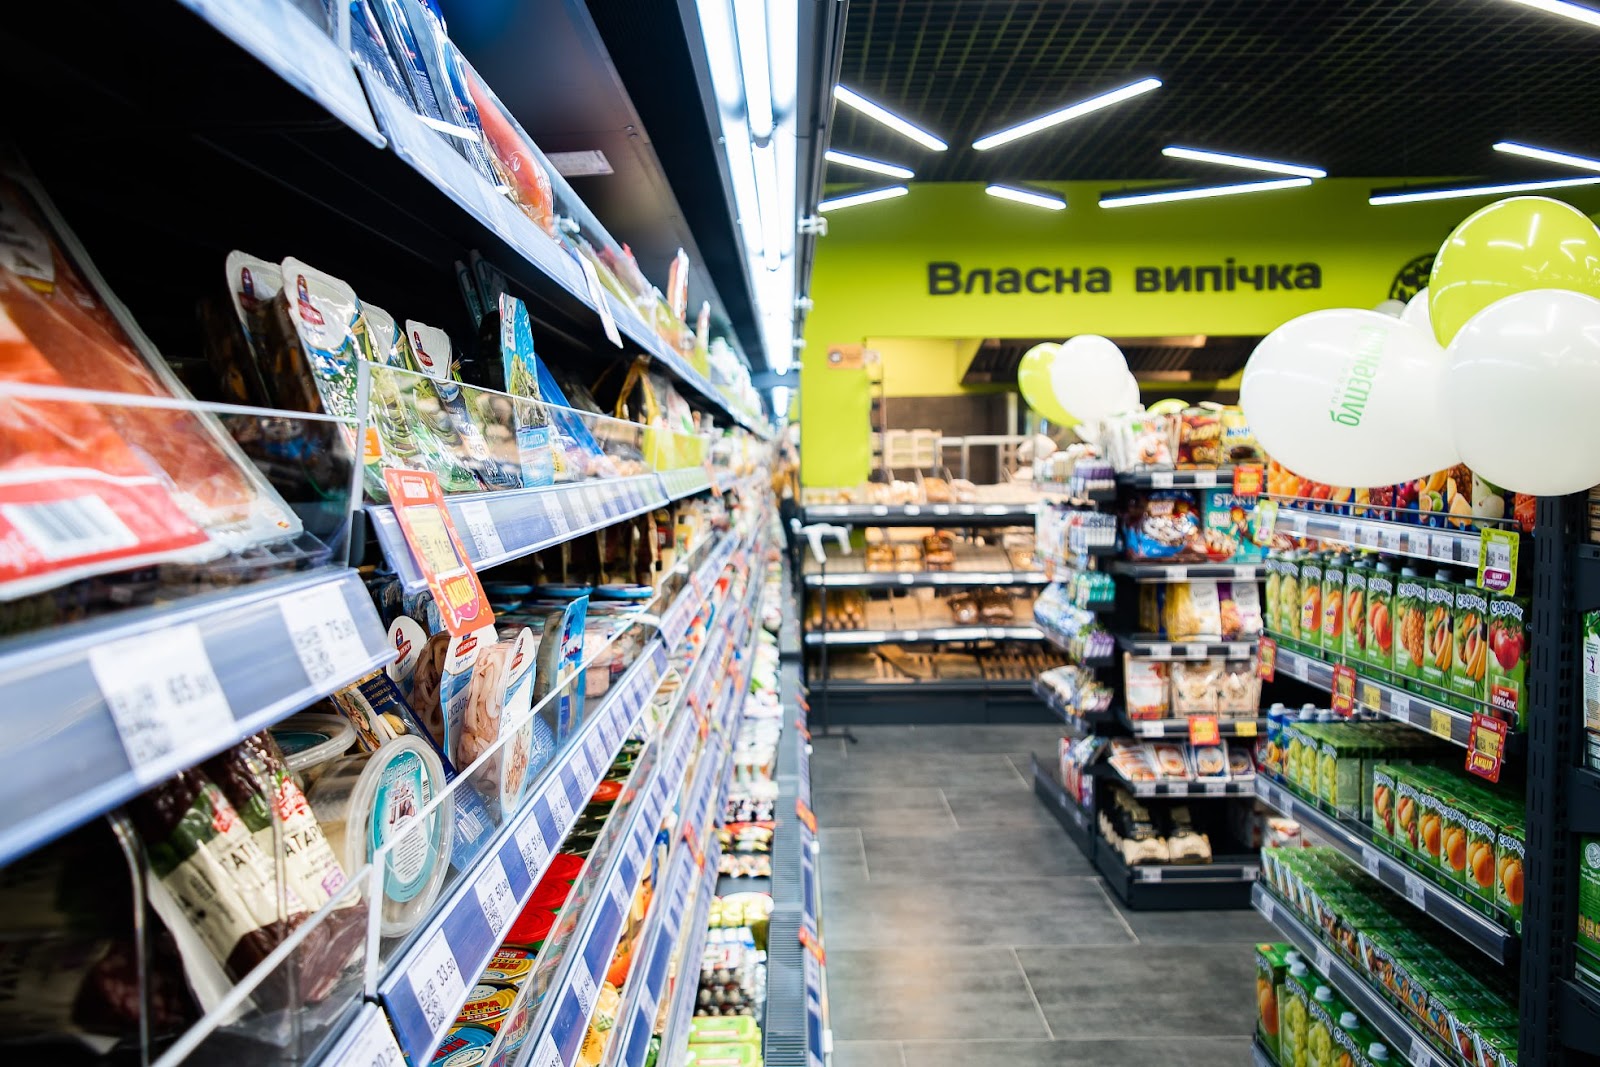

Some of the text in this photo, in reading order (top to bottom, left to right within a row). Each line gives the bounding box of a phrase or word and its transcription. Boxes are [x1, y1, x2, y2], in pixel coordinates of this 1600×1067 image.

[928, 258, 1321, 295] Власна випічка
[461, 1000, 501, 1012] КРА
